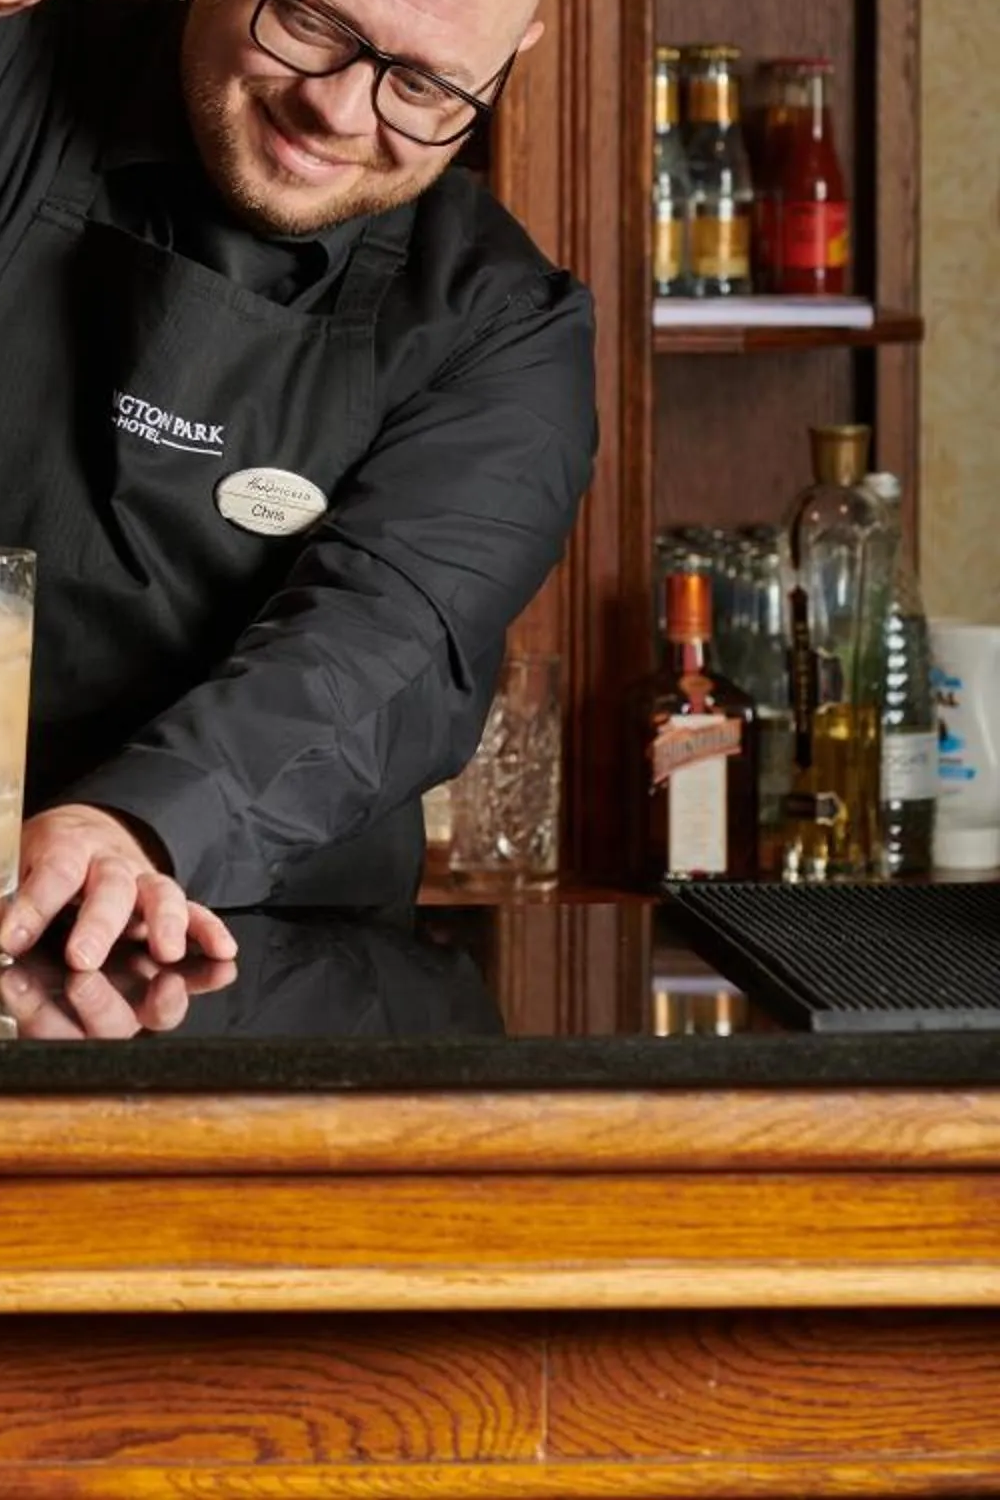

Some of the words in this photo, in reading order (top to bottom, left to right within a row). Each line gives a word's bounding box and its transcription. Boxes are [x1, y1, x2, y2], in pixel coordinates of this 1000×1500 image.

[117, 414, 161, 445] HOTEL
[172, 416, 225, 445] PARK
[251, 503, 286, 522] Chris
